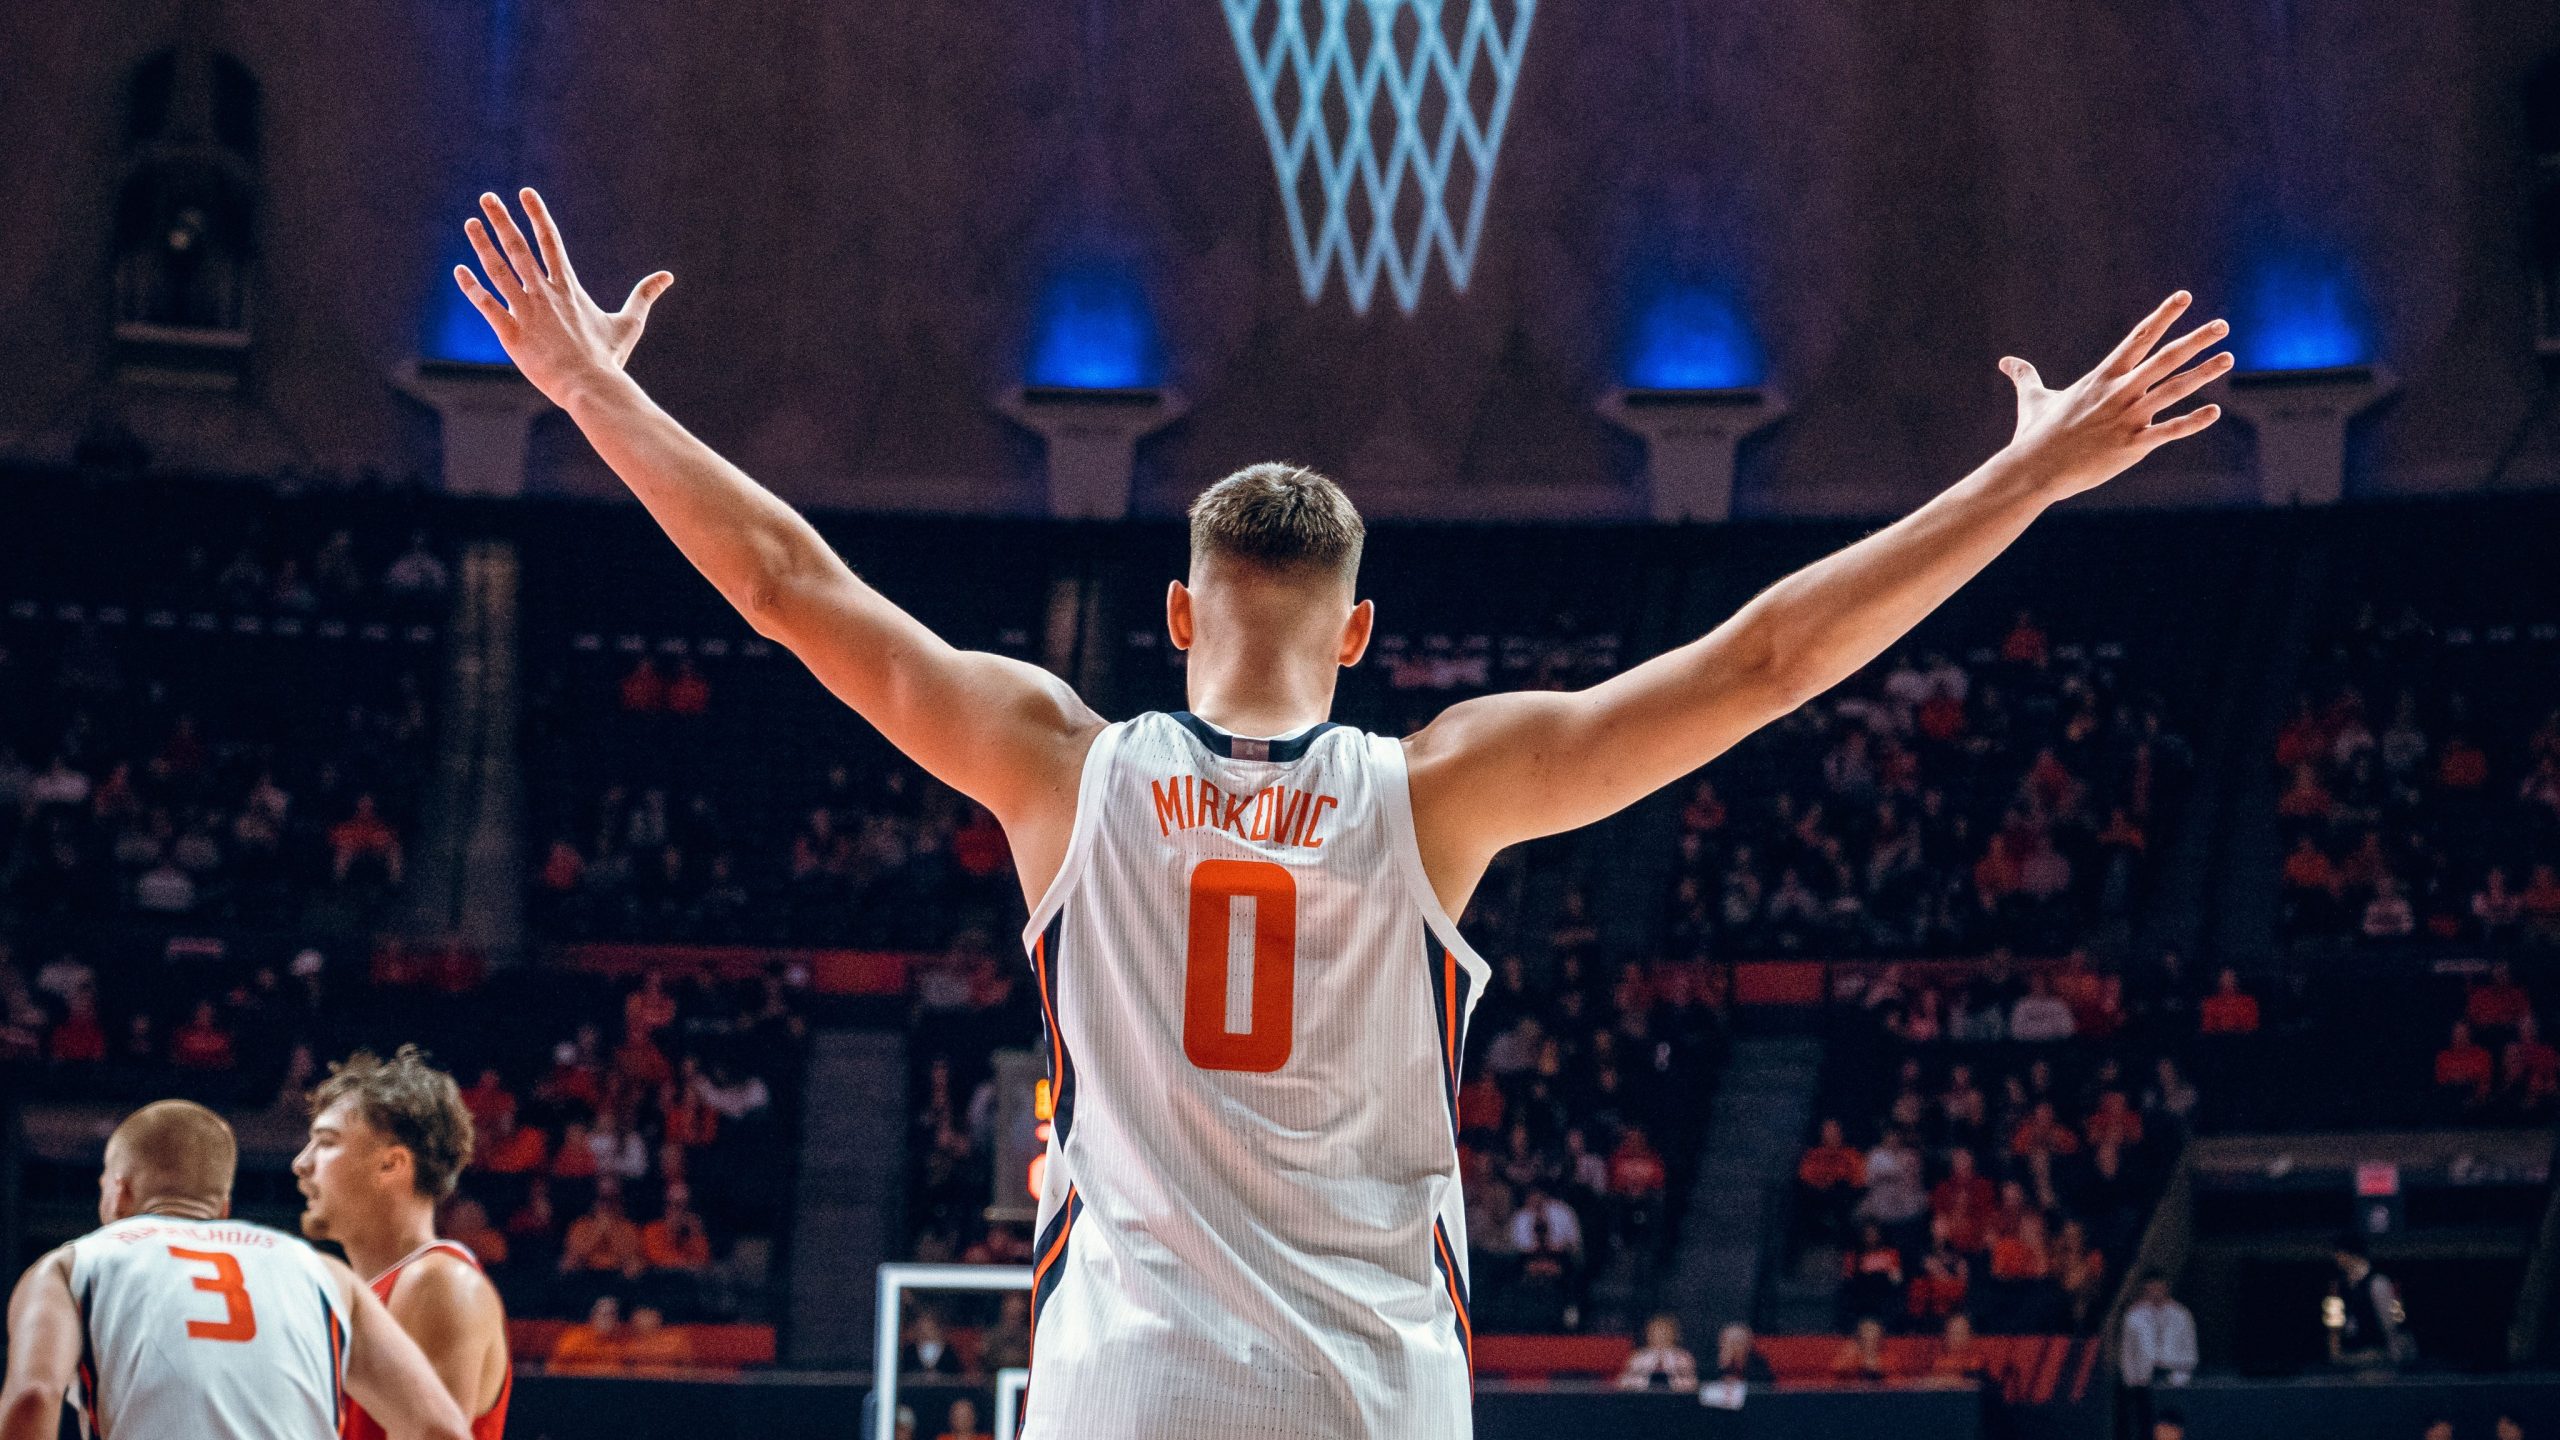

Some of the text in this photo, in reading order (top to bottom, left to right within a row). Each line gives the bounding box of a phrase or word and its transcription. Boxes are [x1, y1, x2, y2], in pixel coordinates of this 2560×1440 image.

[1152, 775, 1338, 848] MIRKOVIC
[1183, 859, 1297, 1073] 0
[166, 1245, 257, 1343] 3
